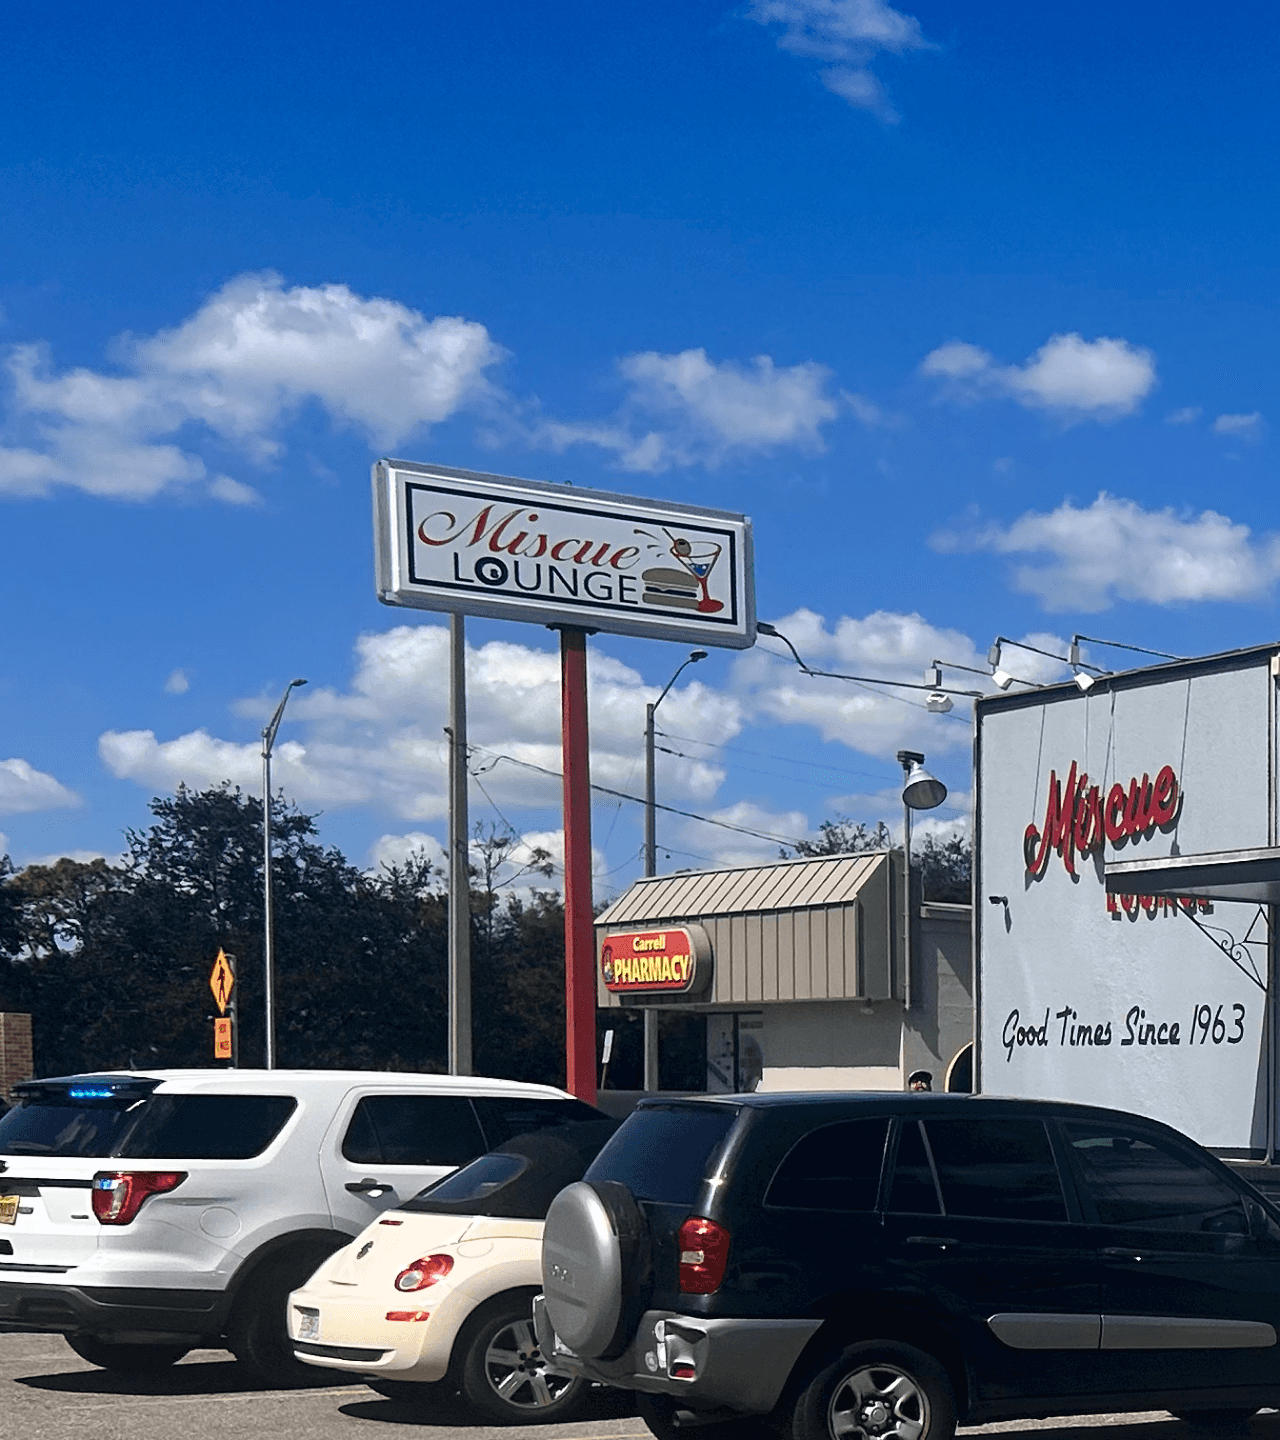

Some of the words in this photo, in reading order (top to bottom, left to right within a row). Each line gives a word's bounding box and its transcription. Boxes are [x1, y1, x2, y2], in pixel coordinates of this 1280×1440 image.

[418, 504, 640, 570] Miscue
[453, 552, 639, 605] LOUNGE
[614, 954, 689, 983] PHARMACY
[632, 933, 666, 951] Carrell
[1002, 1007, 1050, 1063] Good
[1056, 1005, 1112, 1046] Times
[1120, 1005, 1180, 1046] Since
[1189, 1003, 1246, 1045] 1963
